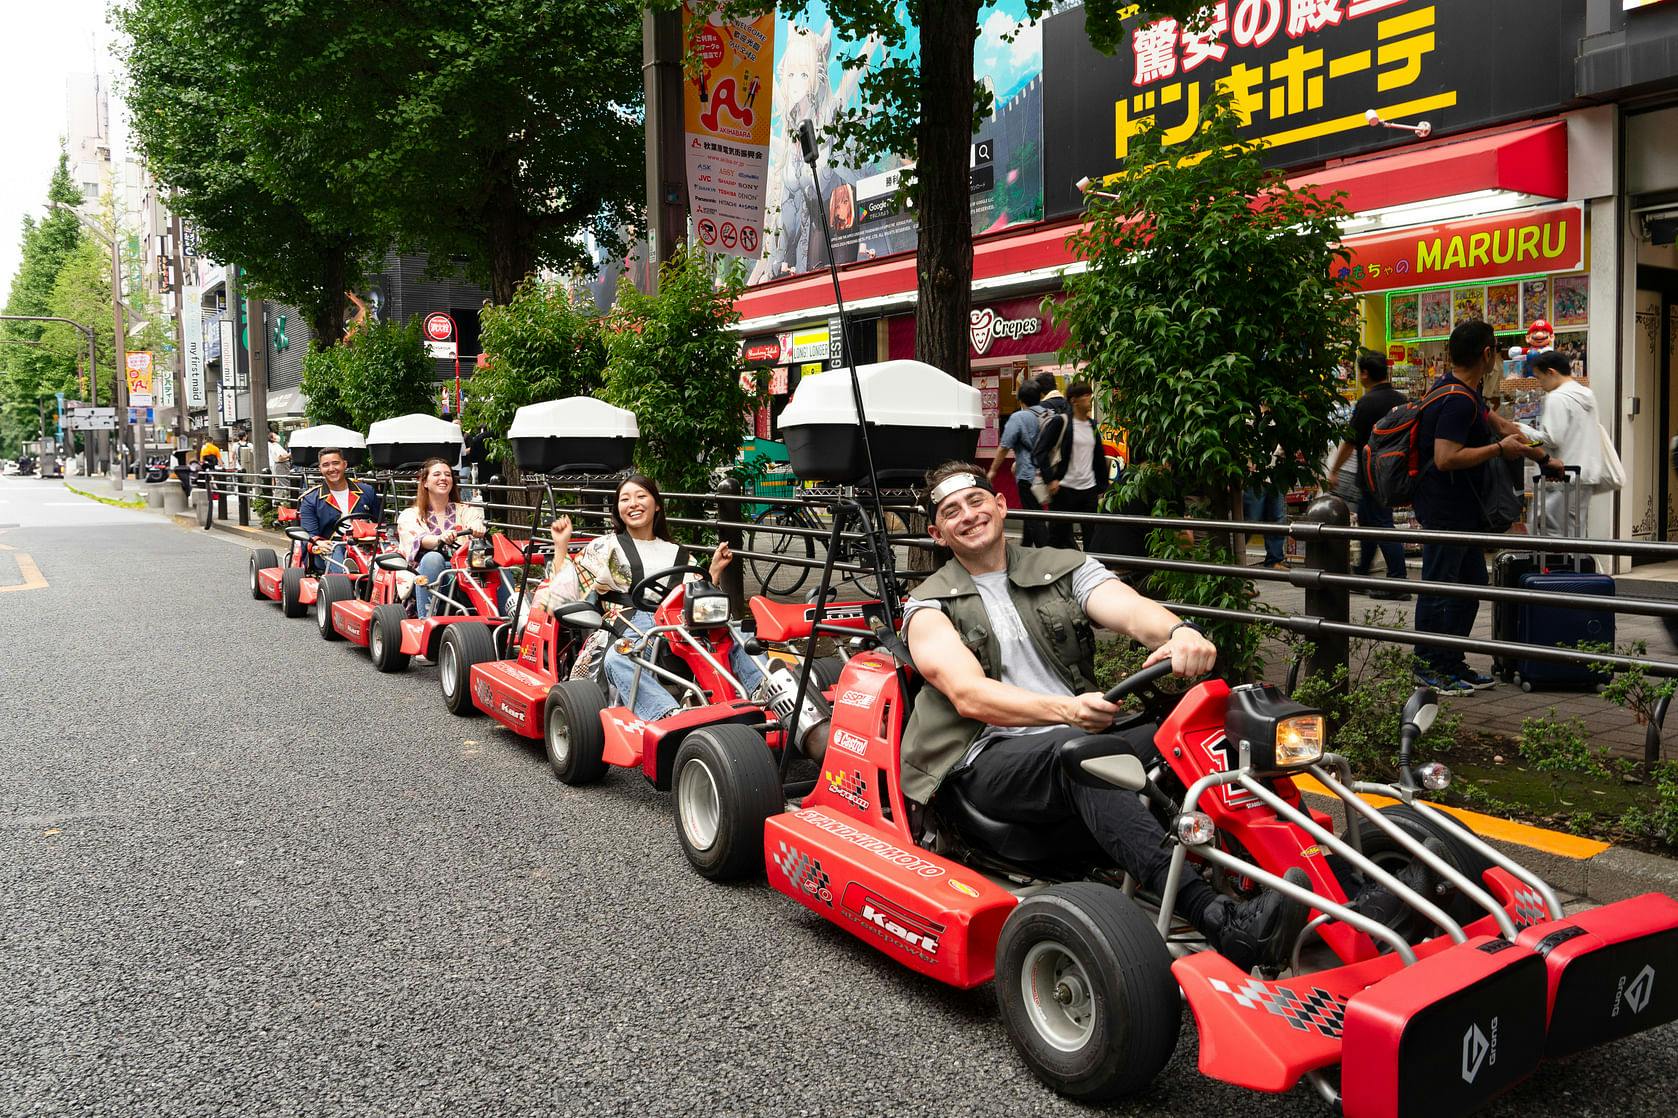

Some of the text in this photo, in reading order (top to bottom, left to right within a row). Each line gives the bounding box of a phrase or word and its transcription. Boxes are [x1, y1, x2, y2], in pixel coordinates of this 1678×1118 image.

[1132, 0, 1400, 86] 驚安の殿
[720, 127, 752, 138] AKIHABARA
[695, 195, 716, 203] Panasonic
[718, 188, 737, 197] TOSHIBA
[738, 193, 757, 201] DENON
[868, 200, 887, 211] Google
[1416, 221, 1567, 274] MARURU
[993, 318, 1037, 339] Crepes
[190, 342, 202, 401] my first maid
[501, 702, 525, 721] Kart
[842, 732, 867, 755] Castrol
[794, 810, 946, 878] STANDARDMOTO
[803, 879, 832, 902] 50
[862, 904, 938, 954] Kart
